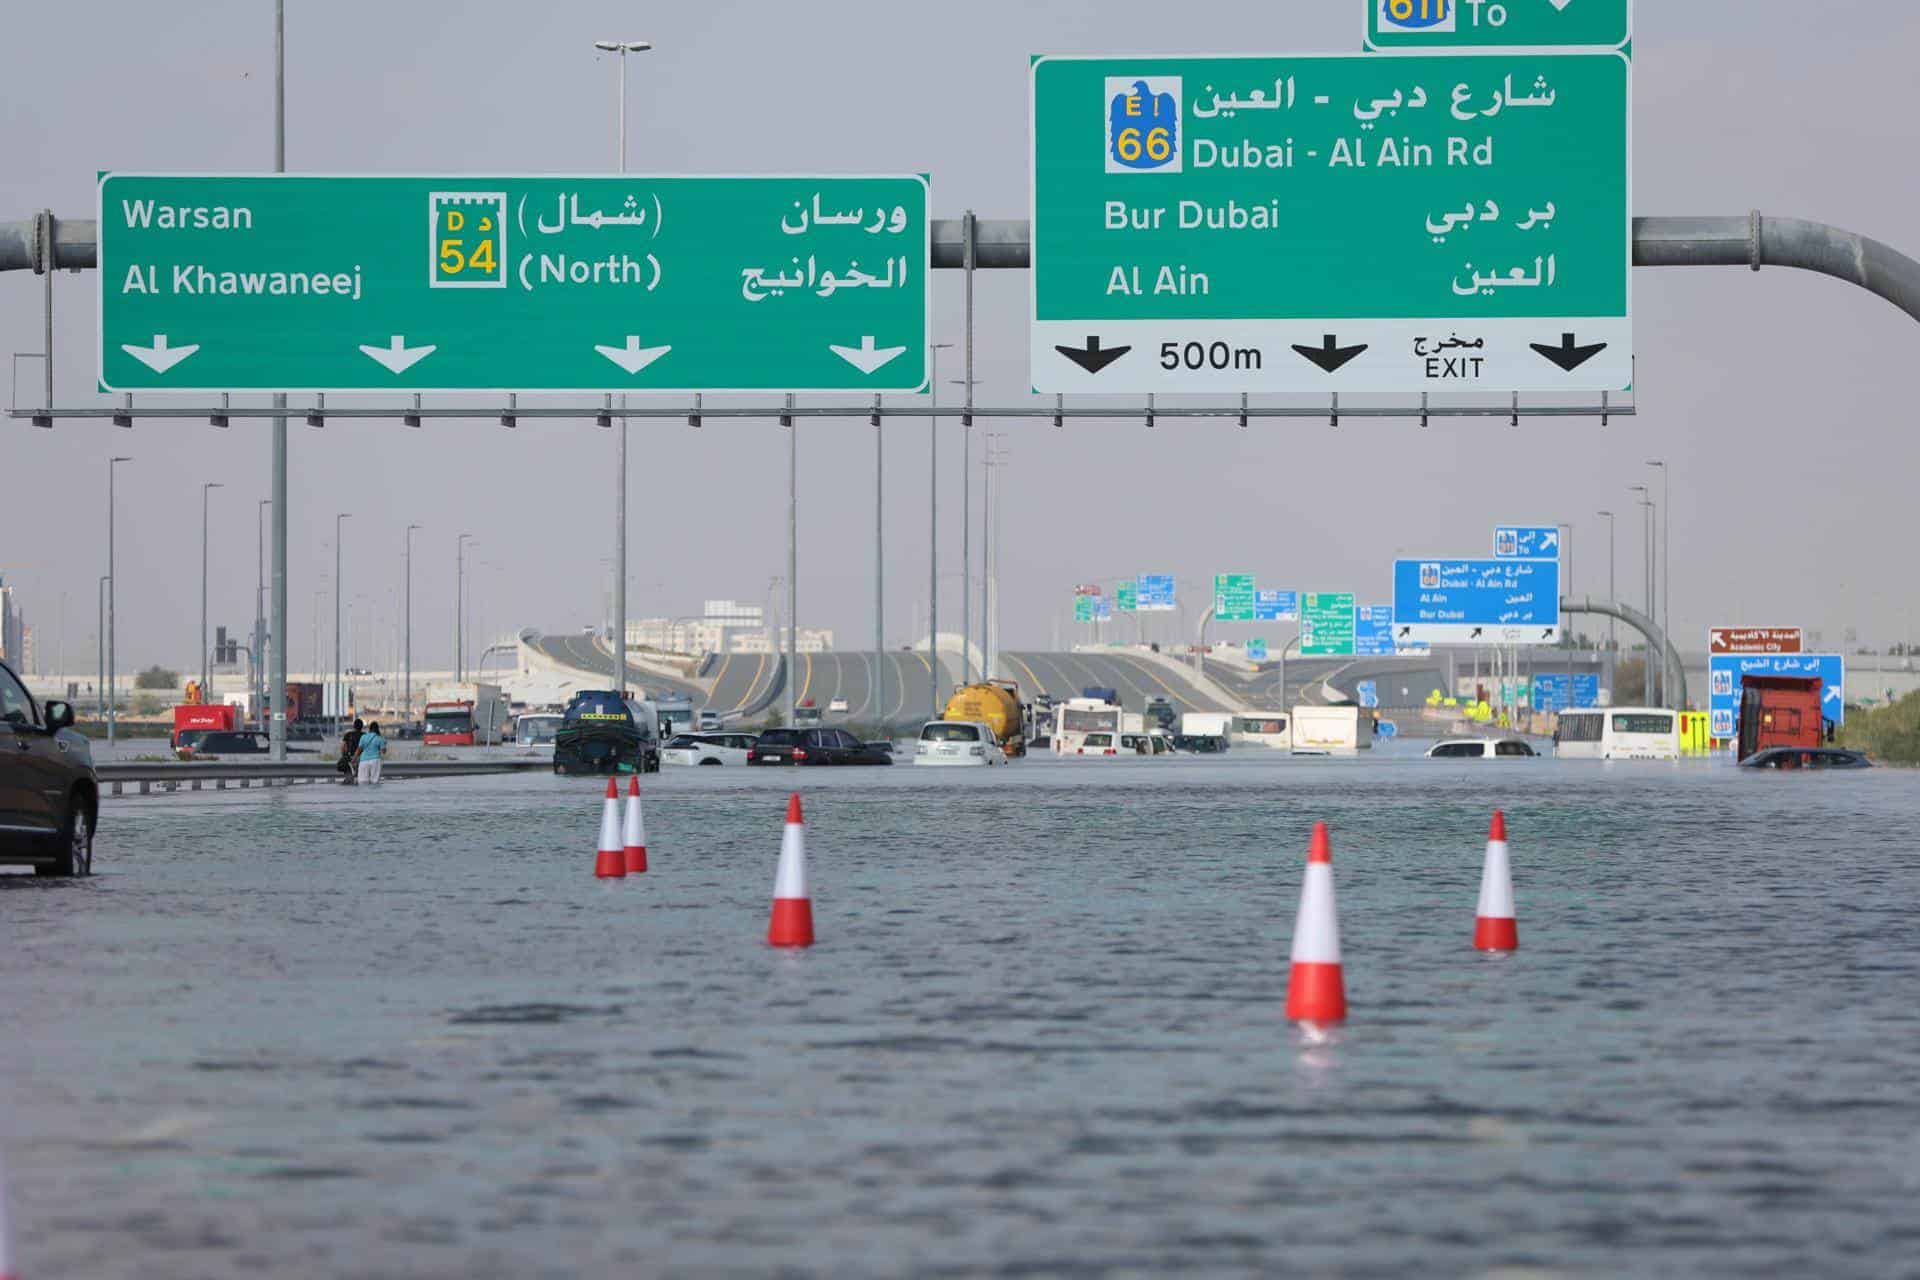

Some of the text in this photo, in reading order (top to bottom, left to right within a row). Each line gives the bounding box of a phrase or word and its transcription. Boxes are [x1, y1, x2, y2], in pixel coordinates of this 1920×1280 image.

[1465, 0, 1507, 26] To
[1126, 96, 1142, 116] E
[1193, 75, 1556, 130] شارع دبي - العين
[1118, 127, 1170, 161] 66
[1193, 139, 1293, 168] Dubai
[1328, 138, 1366, 167] Al
[1377, 137, 1432, 167] Ain
[1447, 137, 1492, 165] Rd
[122, 199, 252, 229] Warsan
[447, 211, 465, 231] D
[518, 192, 662, 239] (شمال)
[781, 193, 907, 234] ورسان
[1105, 199, 1278, 229] Bur Dubai
[1425, 199, 1556, 243] بر دبي
[440, 239, 497, 274] 54
[122, 265, 361, 300] Al Khawaneej
[519, 253, 661, 291] (North)
[742, 256, 907, 301] الخوانيج
[1106, 265, 1209, 295] Al Ain
[1452, 255, 1556, 296] العين
[1160, 341, 1261, 370] 500m
[1413, 333, 1484, 356] مخرج
[1425, 357, 1484, 378] EXIT
[1420, 594, 1448, 603] Al Ain
[1441, 578, 1469, 589] Dubai
[1475, 578, 1486, 589] Al
[1487, 578, 1504, 589] Ain
[1505, 578, 1518, 589] Rd
[1420, 610, 1465, 619] Bur Dubai
